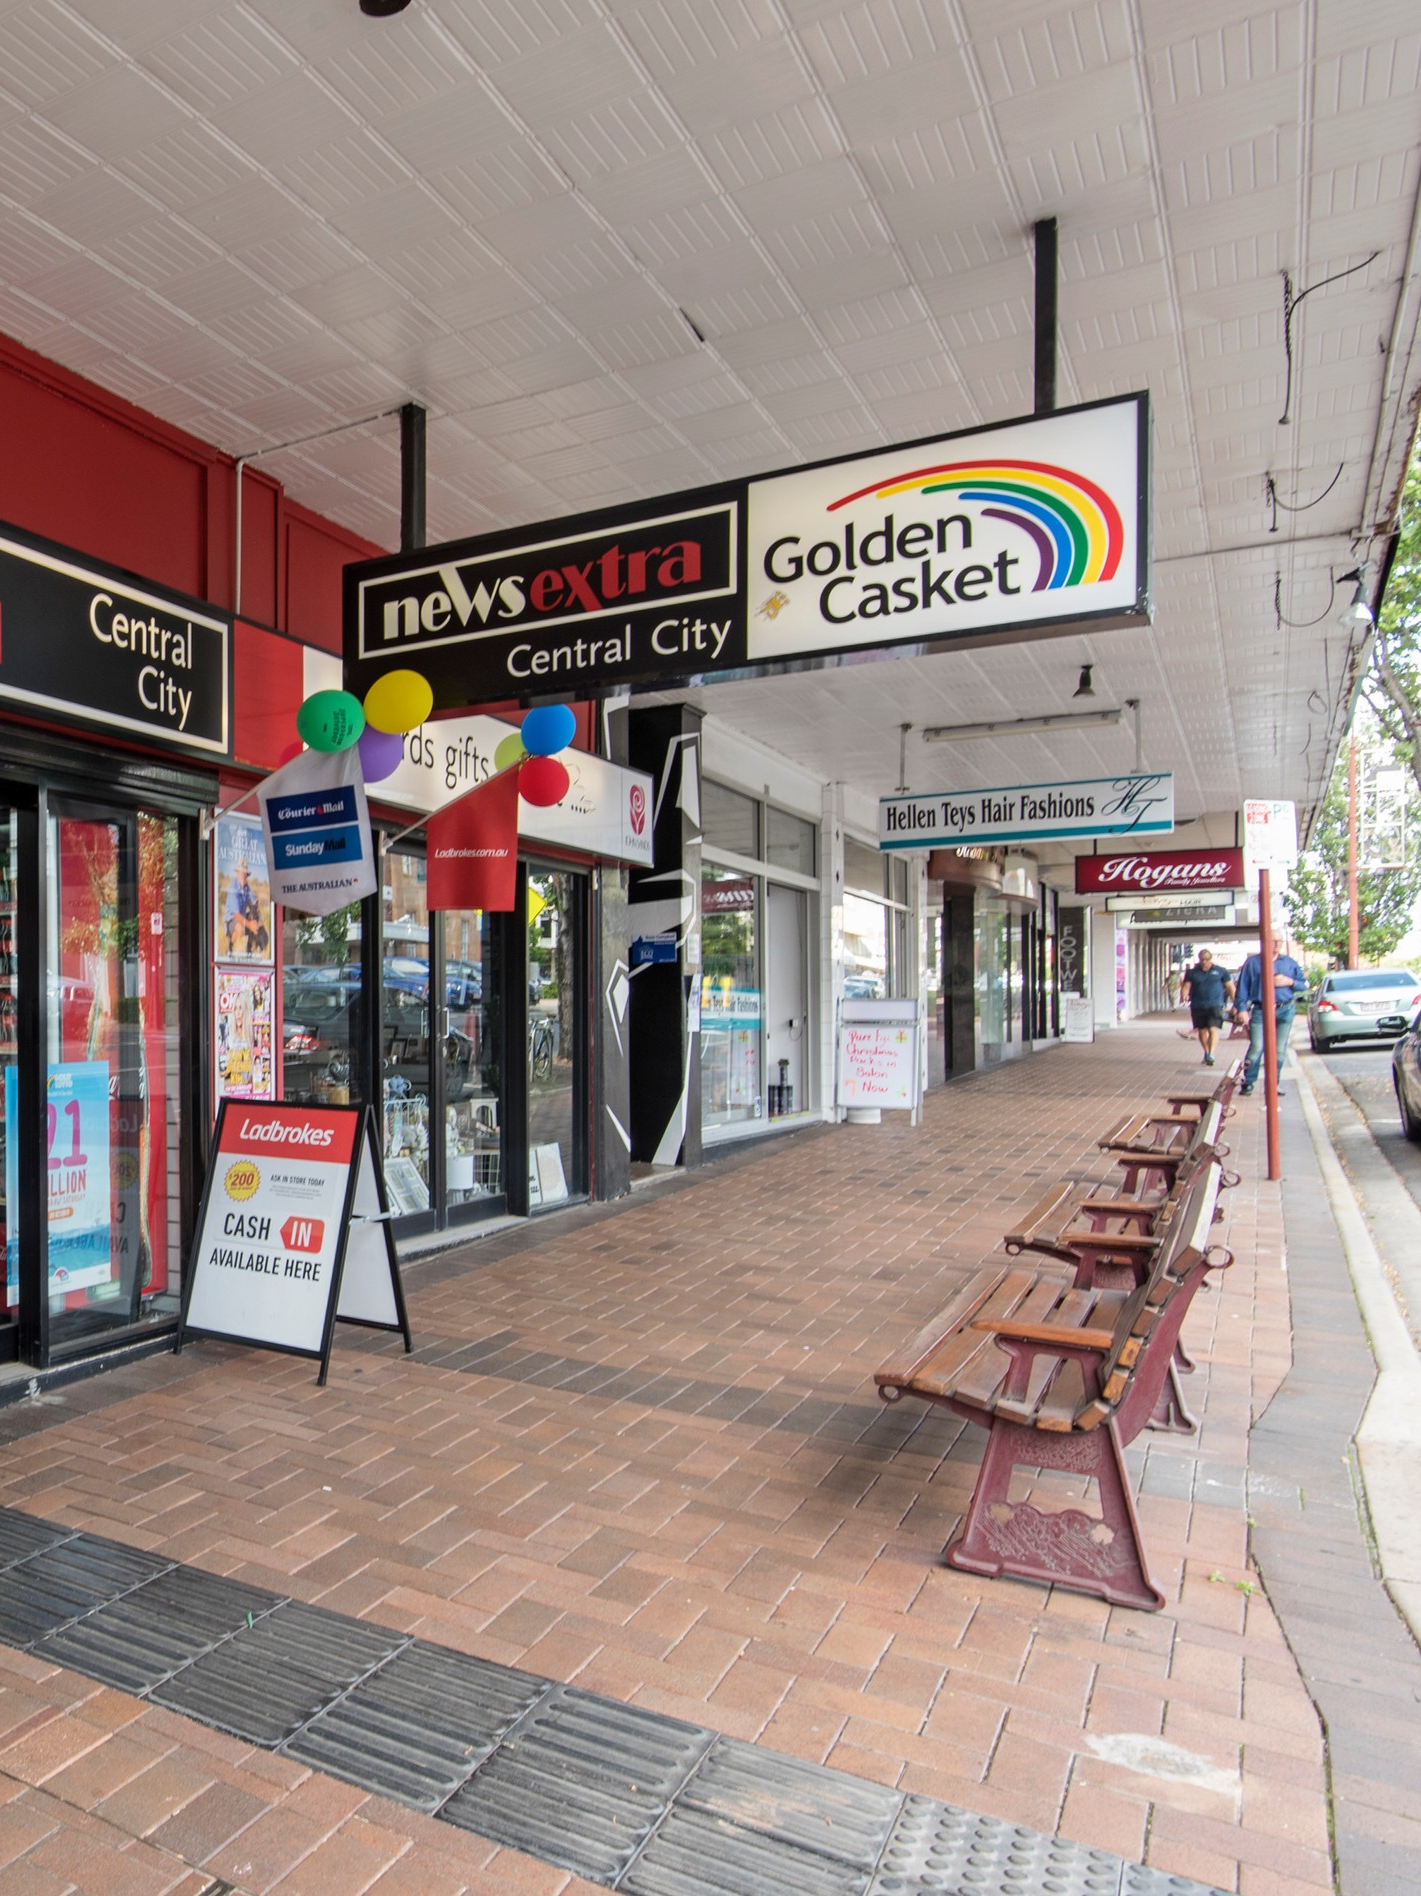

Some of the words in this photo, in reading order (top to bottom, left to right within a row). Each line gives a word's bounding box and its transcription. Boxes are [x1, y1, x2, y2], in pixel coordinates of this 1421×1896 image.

[764, 512, 973, 585] Golden
[530, 540, 702, 614] extra
[819, 549, 1021, 625] Casket
[89, 593, 193, 670] Central
[506, 634, 632, 678] Central
[651, 617, 731, 659] City
[138, 666, 192, 731] City
[445, 736, 489, 790] gifts
[278, 807, 317, 821] Courier
[323, 801, 344, 814] Mail
[887, 807, 936, 831] Hellen
[942, 801, 975, 832] Teys
[981, 796, 1016, 824] Hair
[1020, 792, 1095, 820] Fashions
[285, 840, 325, 857] Sunday
[435, 848, 508, 858] Ladbrokes.com.au
[282, 884, 298, 893] THE
[298, 878, 353, 892] AUSTRALIAN
[1098, 856, 1232, 888] Hogans
[1060, 925, 1078, 991] FOOTWE
[846, 1043, 898, 1057] Christmas
[856, 1067, 888, 1078] Salon
[862, 1081, 889, 1093] Now
[239, 1119, 334, 1146] Ladbrokes
[270, 1174, 281, 1182] ASK
[282, 1175, 289, 1183] IN
[289, 1176, 306, 1185] STORE
[307, 1177, 326, 1187] TODAY
[223, 1212, 271, 1240] CASH
[290, 1221, 312, 1247] IN
[209, 1248, 281, 1275] AVAILABLE
[284, 1258, 322, 1282] HERE
